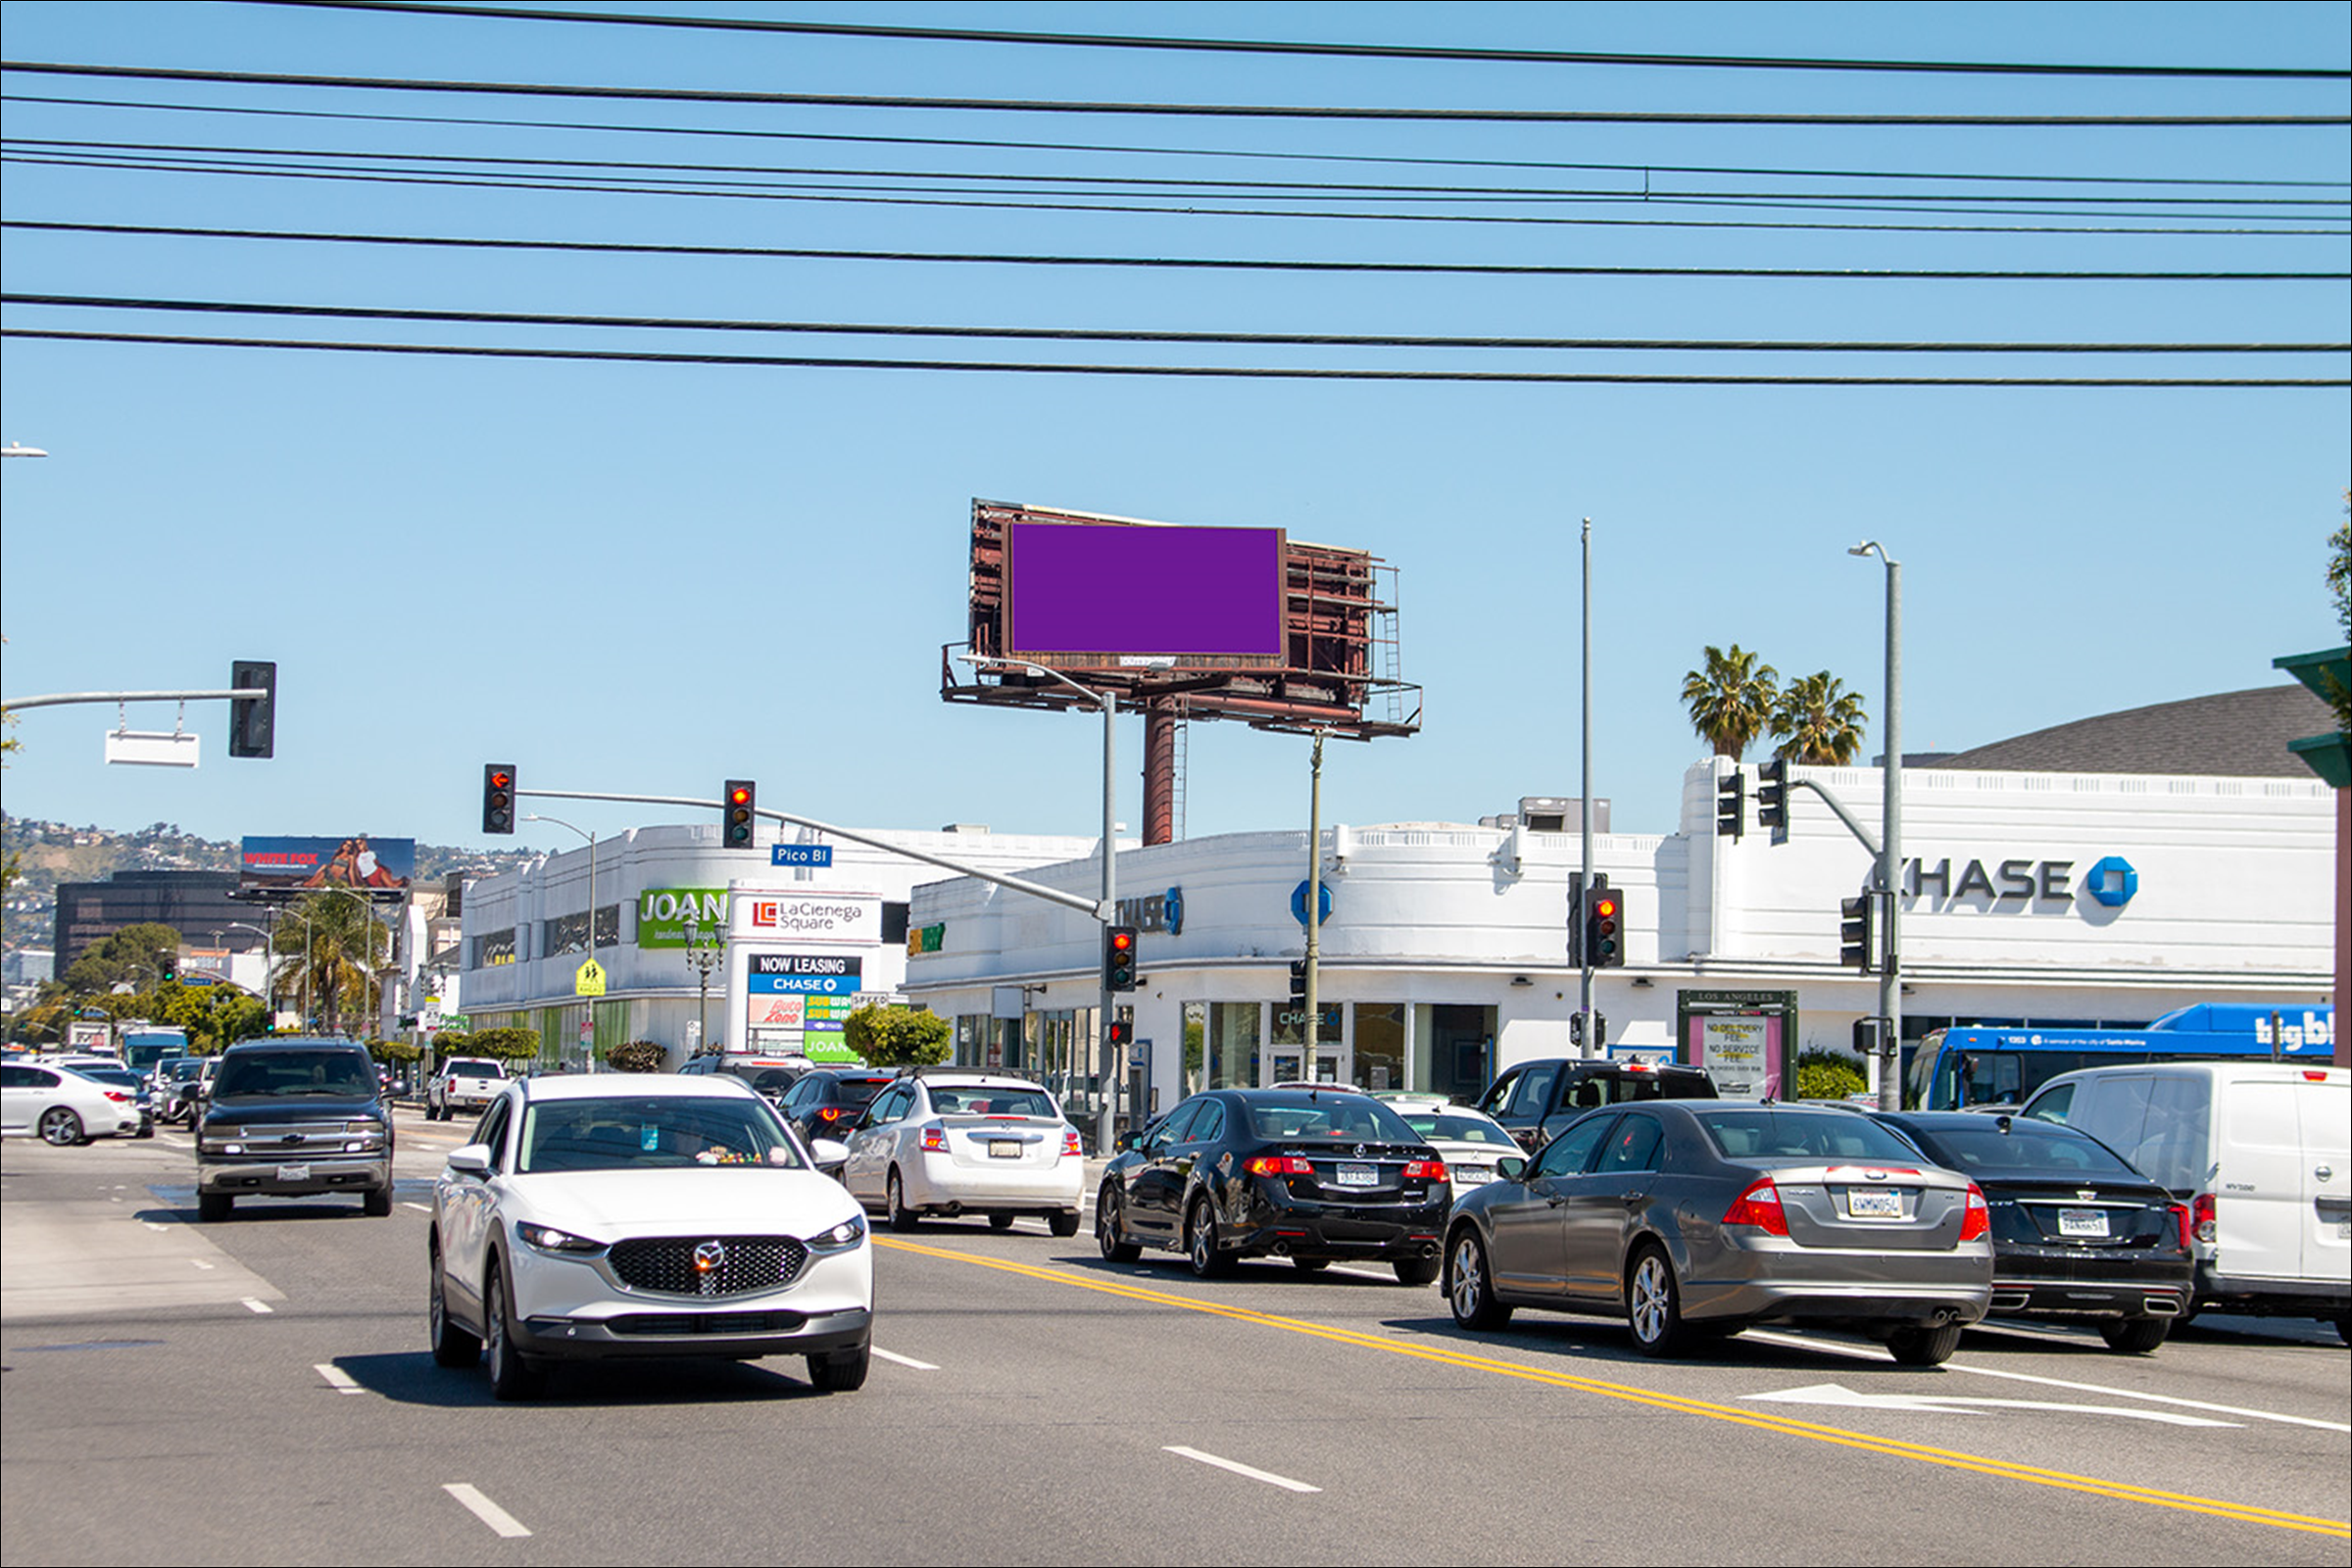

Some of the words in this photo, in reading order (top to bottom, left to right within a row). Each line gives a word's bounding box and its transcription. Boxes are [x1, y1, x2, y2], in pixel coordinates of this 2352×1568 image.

[243, 852, 288, 865] WHITE
[289, 853, 318, 865] FOX
[777, 848, 808, 861] Pico
[1901, 857, 2076, 901] HASE
[779, 915, 834, 932] Square
[760, 956, 792, 972] NOW
[795, 957, 846, 974] LEASING
[773, 978, 821, 991] CHASE
[853, 996, 888, 1004] SPEED
[1725, 993, 1774, 1002] ANGELES
[771, 999, 803, 1011] Auto
[764, 1009, 799, 1024] Zone
[1279, 1012, 1325, 1025] CHAE
[1707, 1023, 1718, 1032] NO
[1720, 1023, 1764, 1033] DELIVERY
[1709, 1044, 1721, 1053] NO
[1723, 1045, 1760, 1054] SERVICE
